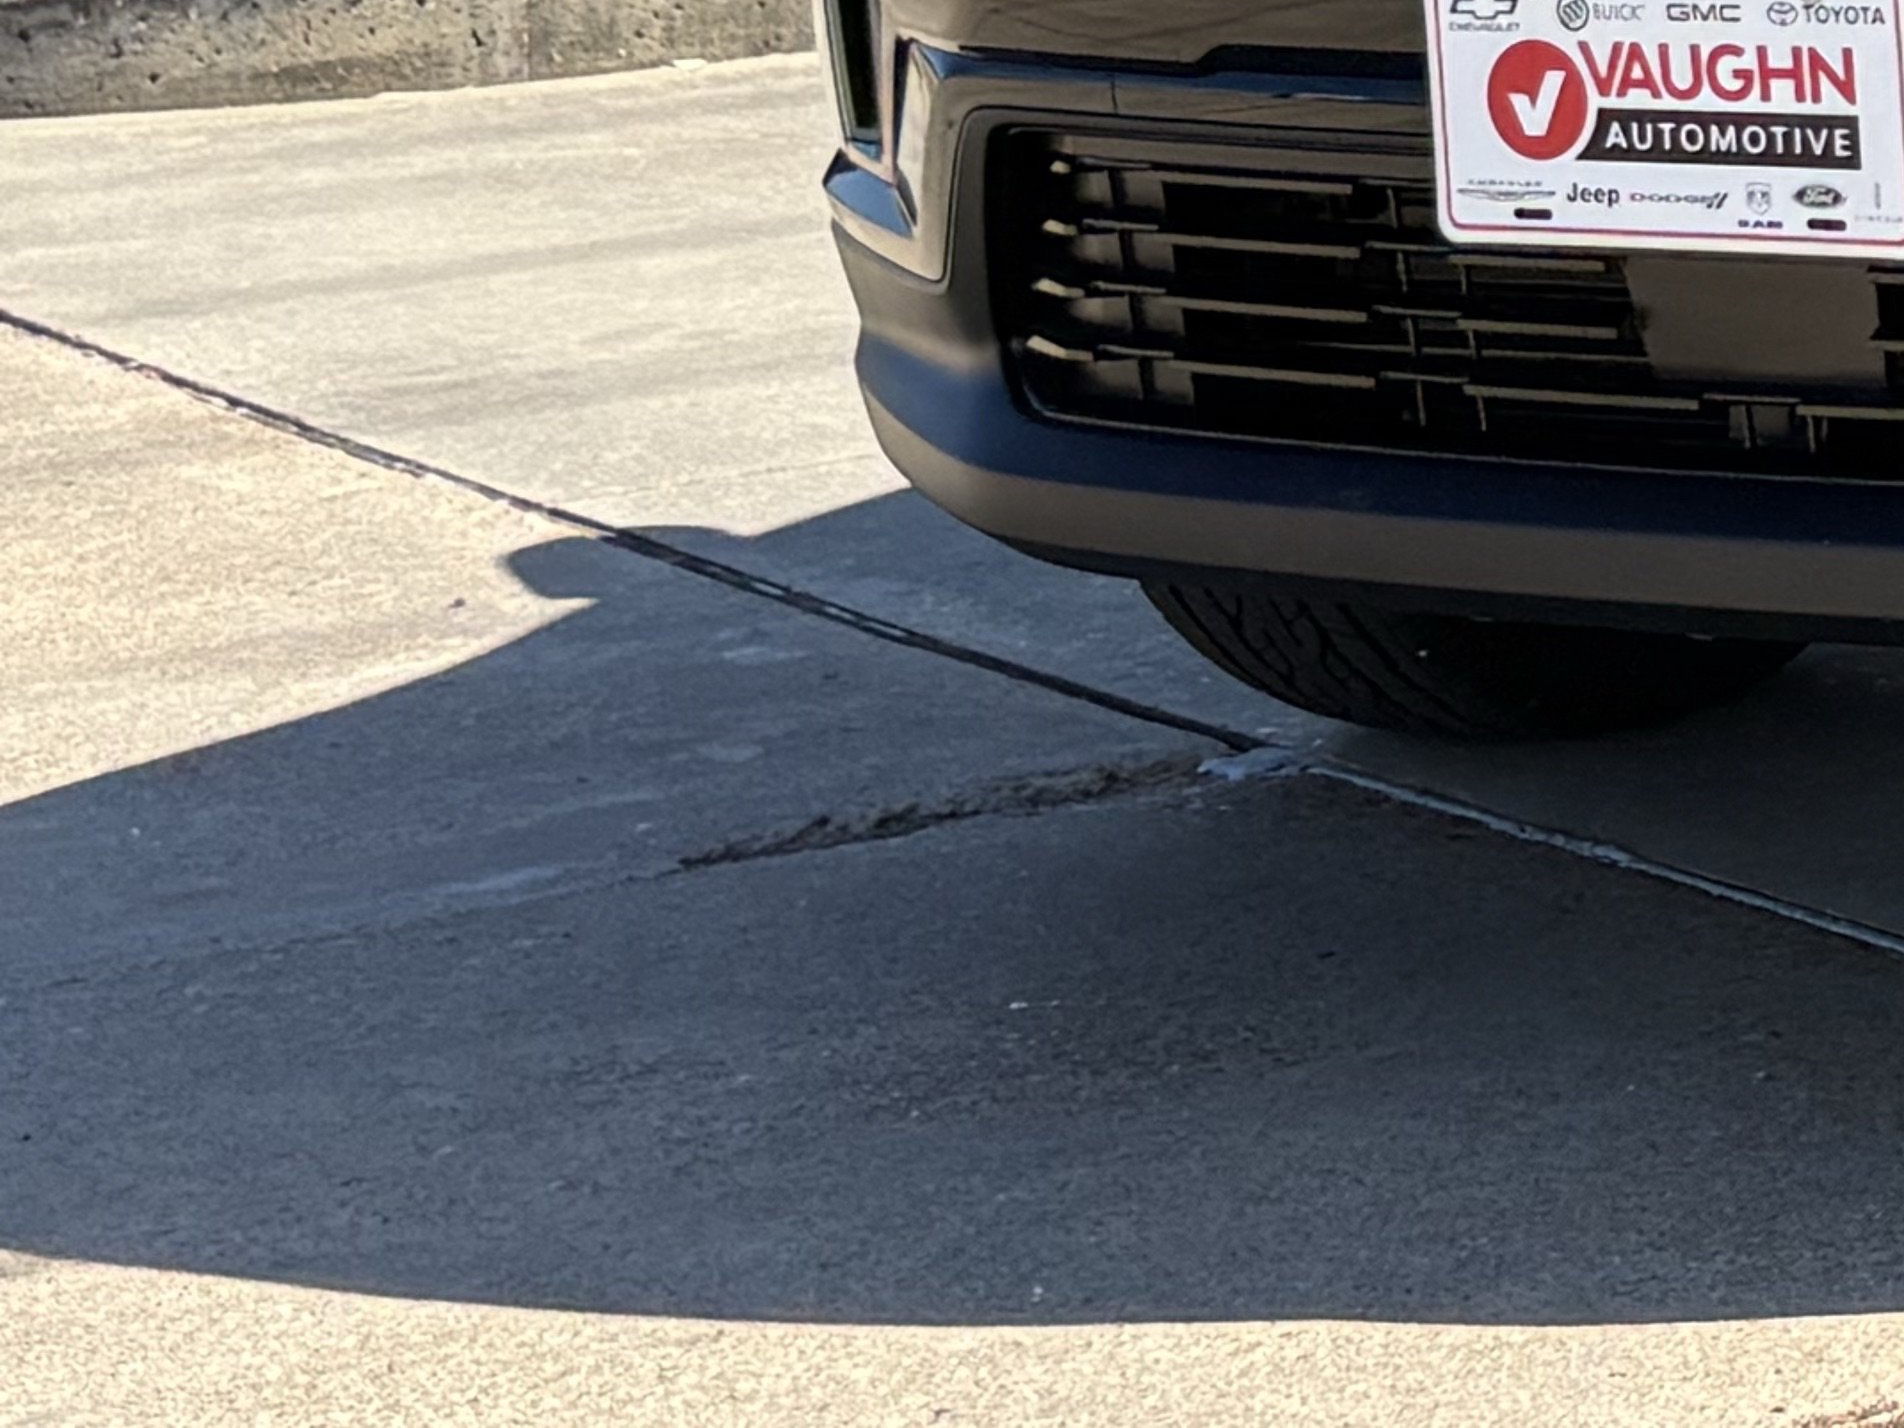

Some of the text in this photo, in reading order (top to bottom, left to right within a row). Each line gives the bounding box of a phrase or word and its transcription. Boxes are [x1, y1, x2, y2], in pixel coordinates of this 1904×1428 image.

[1592, 2, 1646, 21] BUICK
[1666, 2, 1742, 23] GMC
[1803, 4, 1886, 26] TOYOTA
[1577, 40, 1858, 106] VAUGHN
[1605, 120, 1854, 158] AUTOMOTIVE
[1566, 182, 1621, 208] Jeep
